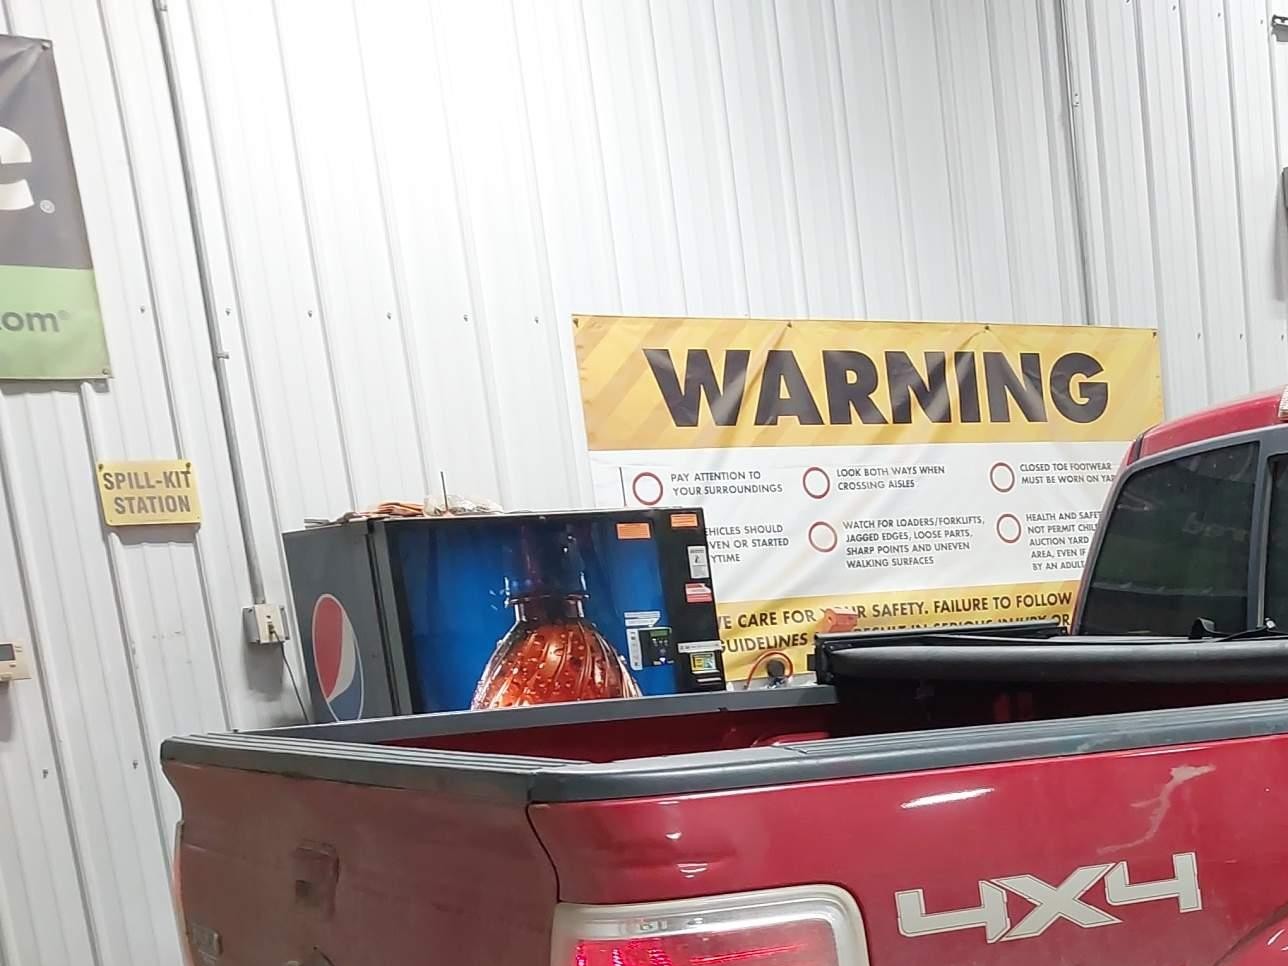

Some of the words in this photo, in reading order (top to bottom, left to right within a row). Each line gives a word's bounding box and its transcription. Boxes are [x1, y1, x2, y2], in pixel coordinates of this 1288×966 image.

[0, 311, 60, 332] om
[643, 348, 1108, 427] WARNING
[837, 468, 861, 477] LOOK
[864, 467, 889, 476] BOTH
[892, 466, 917, 476] WAYS
[919, 466, 945, 475] WHEN
[1020, 464, 1050, 472] CLOSED
[1053, 463, 1067, 471] TOE
[1070, 462, 1112, 471] FOOTWEAR
[103, 471, 191, 490] SPILL-KIT
[671, 473, 690, 482] PAY
[694, 472, 746, 481] ATTENTION
[749, 471, 761, 480] TO
[1022, 476, 1044, 484] MUST
[1046, 476, 1056, 484] BE
[1058, 475, 1084, 484] WORN
[1087, 475, 1099, 483] ON
[673, 487, 702, 496] YOUR
[704, 484, 783, 495] SURROUNDINGS
[838, 481, 885, 491] CROSSING
[888, 480, 914, 489] AISLES
[114, 495, 191, 514] STATION
[843, 520, 875, 529] WATCH
[877, 519, 893, 528] FOR
[896, 516, 985, 527] LOADERS/FORKLIFTS,
[1026, 513, 1056, 522] HEALTH
[1058, 512, 1077, 521] AND
[705, 527, 741, 537] EHICLES
[744, 525, 783, 535] SHOULD
[1027, 525, 1045, 534] NOT
[1047, 524, 1075, 533] PERMIT
[1078, 523, 1097, 532] CHIL
[846, 533, 879, 542] JAGGED
[882, 531, 912, 541] EDGES,
[914, 530, 942, 540] LOOSE
[1029, 537, 1065, 546] AUCTION
[1068, 536, 1089, 545] YARD
[709, 540, 730, 550] VEN
[734, 540, 749, 549] OR
[751, 538, 789, 547] STARTED
[846, 546, 874, 555] SHARP
[877, 545, 909, 554] POINTS
[912, 543, 931, 553] AND
[934, 542, 970, 551] UNEVEN
[711, 554, 741, 563] YTIME
[1057, 549, 1077, 558] EVEN
[1079, 549, 1086, 557] IF
[846, 559, 889, 568] WALKING
[891, 557, 934, 566] SURFACES
[1032, 563, 1042, 571] BY
[1045, 562, 1058, 570] AN
[872, 602, 929, 618] SAFETY.
[934, 597, 988, 613] FAILURE
[992, 596, 1011, 609] TO
[1016, 592, 1073, 608] FOLLOW
[737, 611, 777, 628] CARE
[783, 609, 816, 624] FOR
